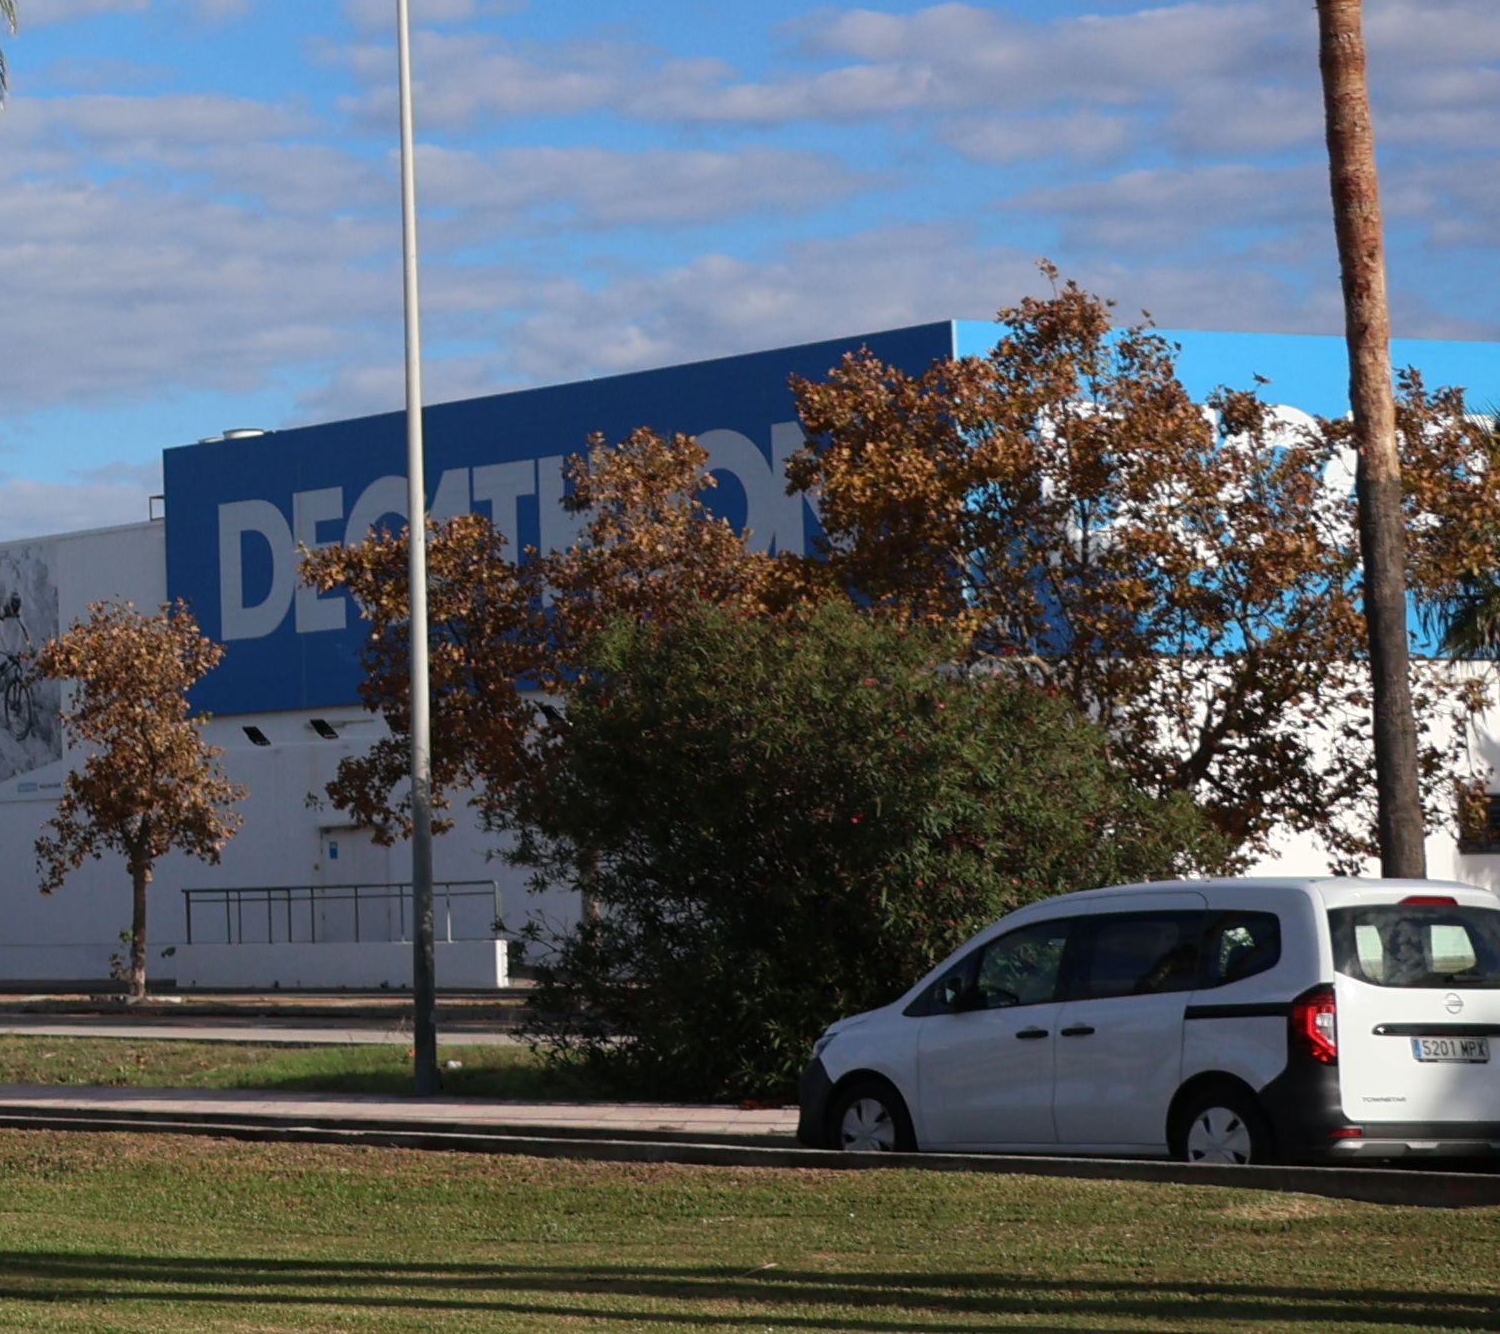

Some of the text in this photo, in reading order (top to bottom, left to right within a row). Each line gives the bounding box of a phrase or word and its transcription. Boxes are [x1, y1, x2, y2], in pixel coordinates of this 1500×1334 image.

[218, 421, 854, 641] DECTHON
[1422, 1040, 1487, 1057] 5201 MPX
